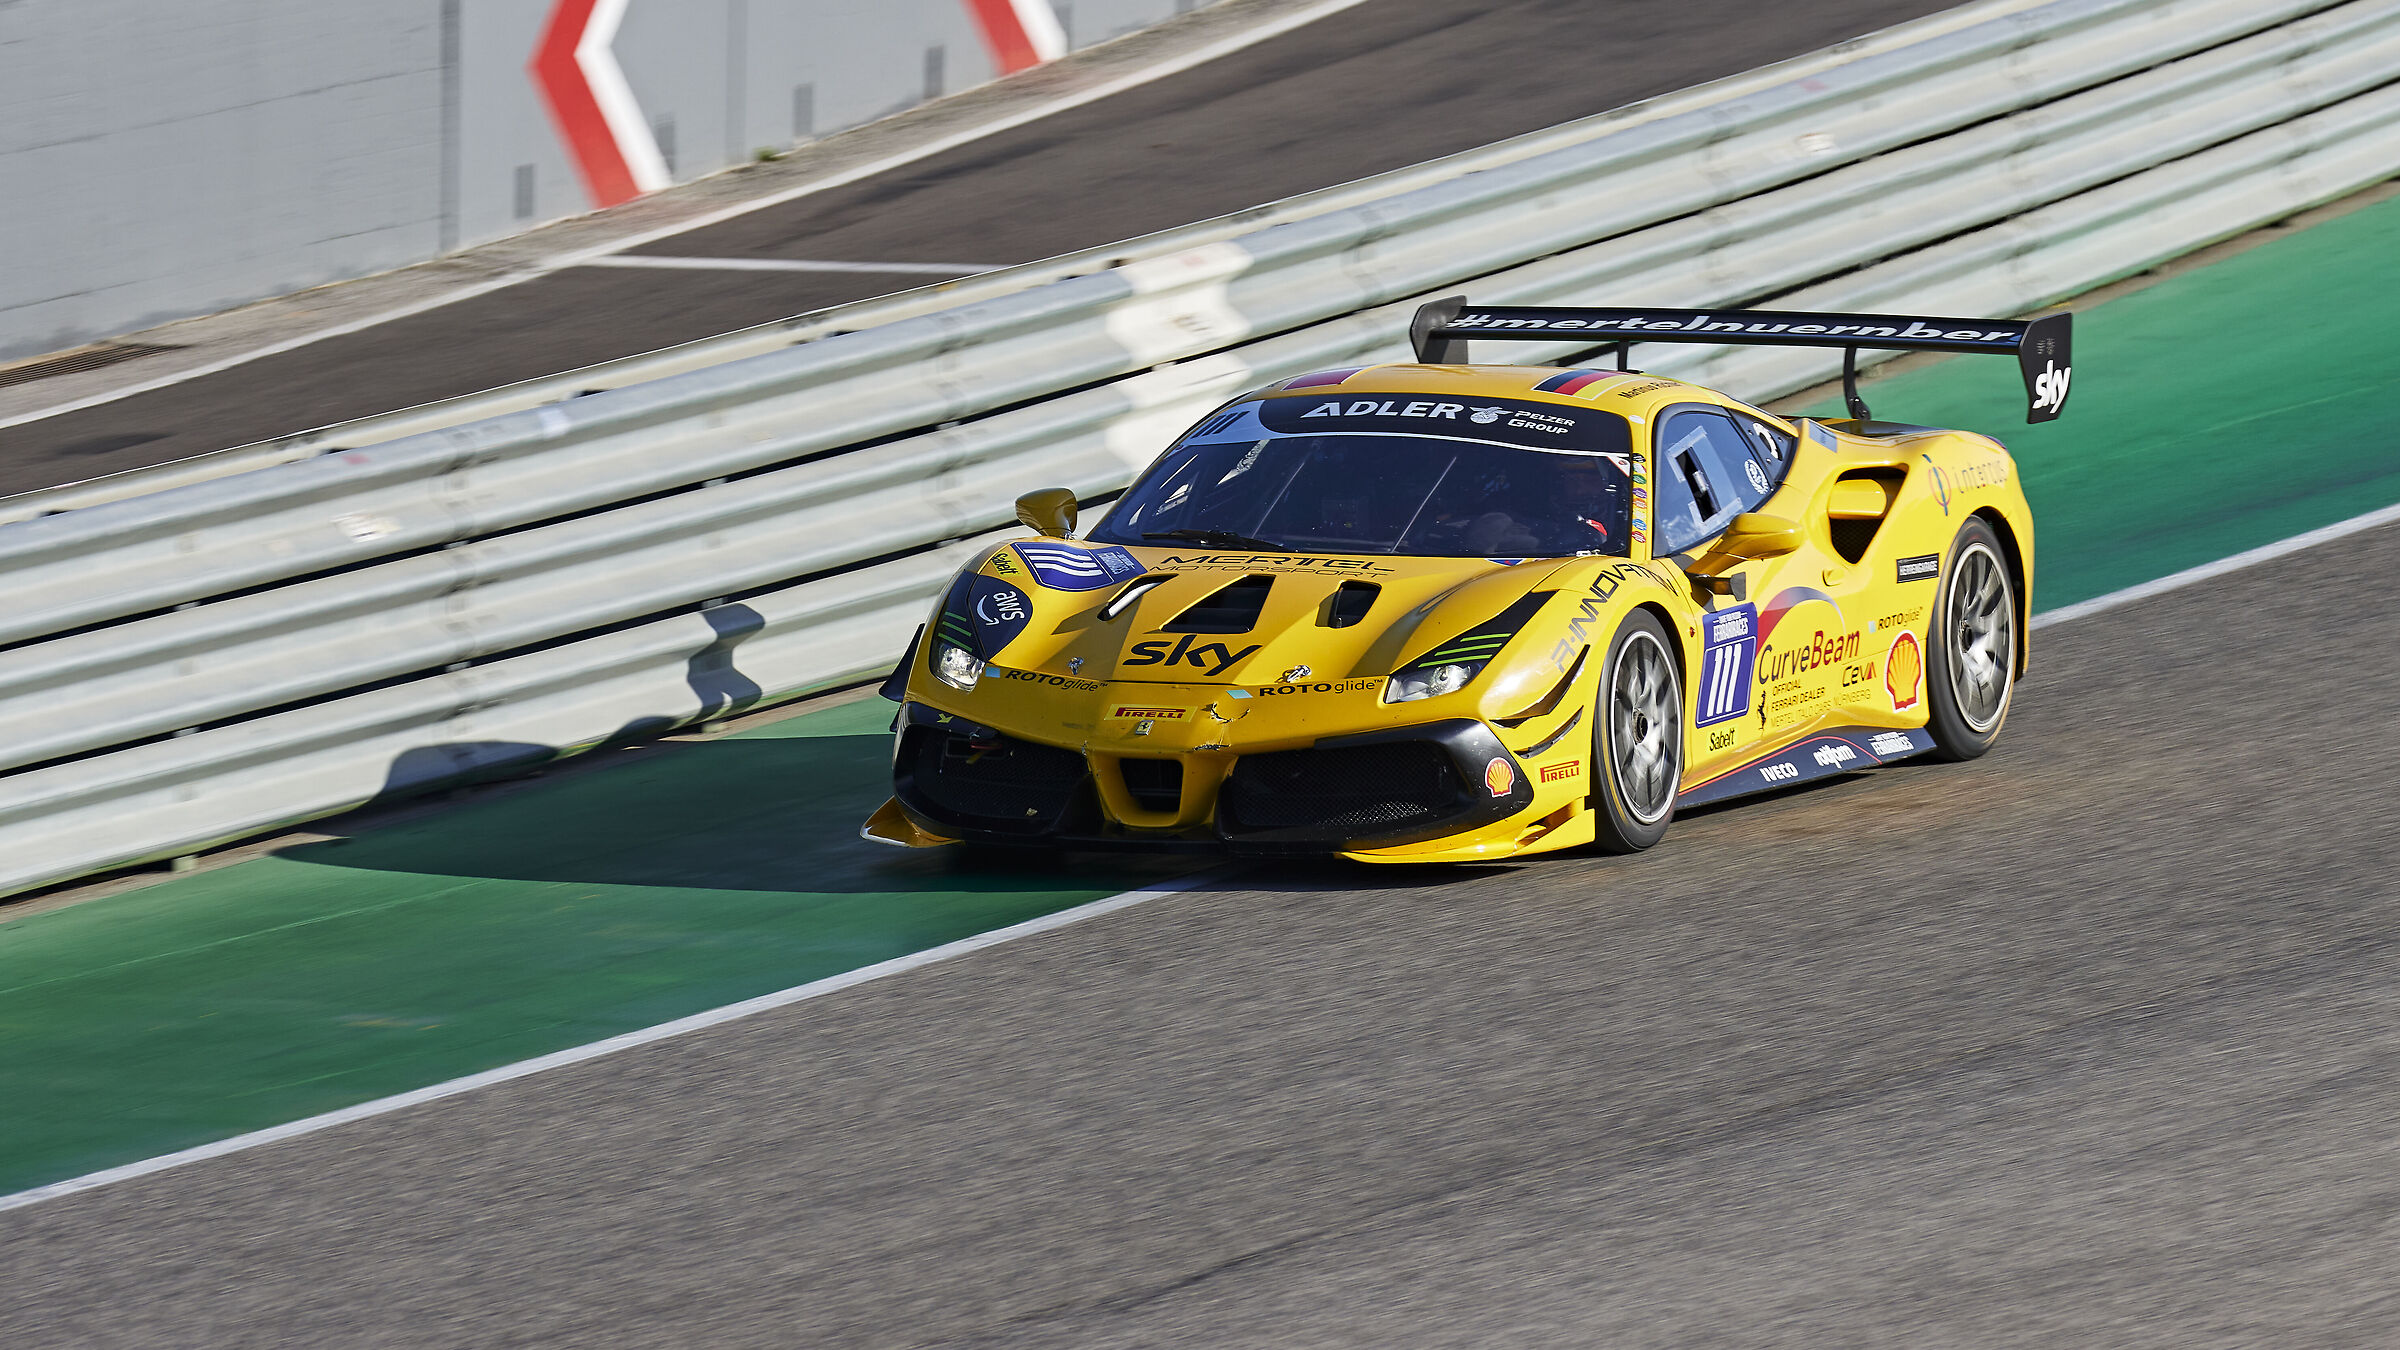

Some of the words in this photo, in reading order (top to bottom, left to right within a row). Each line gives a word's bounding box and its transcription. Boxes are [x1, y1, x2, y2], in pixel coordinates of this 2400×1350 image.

[1446, 314, 2022, 342] #mertelnuernber
[2031, 359, 2071, 413] sky
[1300, 400, 1464, 419] ADLER
[1514, 410, 1576, 428] PELZER
[1507, 419, 1569, 435] GROUP
[1150, 566, 1388, 578] MOTORSPORT
[1161, 555, 1395, 572] MERTEL
[993, 591, 1025, 621] aws
[1122, 634, 1263, 677] sky
[1759, 630, 1860, 685] CurveBeam
[1706, 643, 1742, 717] 111
[1114, 707, 1185, 719] PIRELLI
[1540, 760, 1580, 783] PIRELLI
[1759, 762, 1799, 782] IVECO
